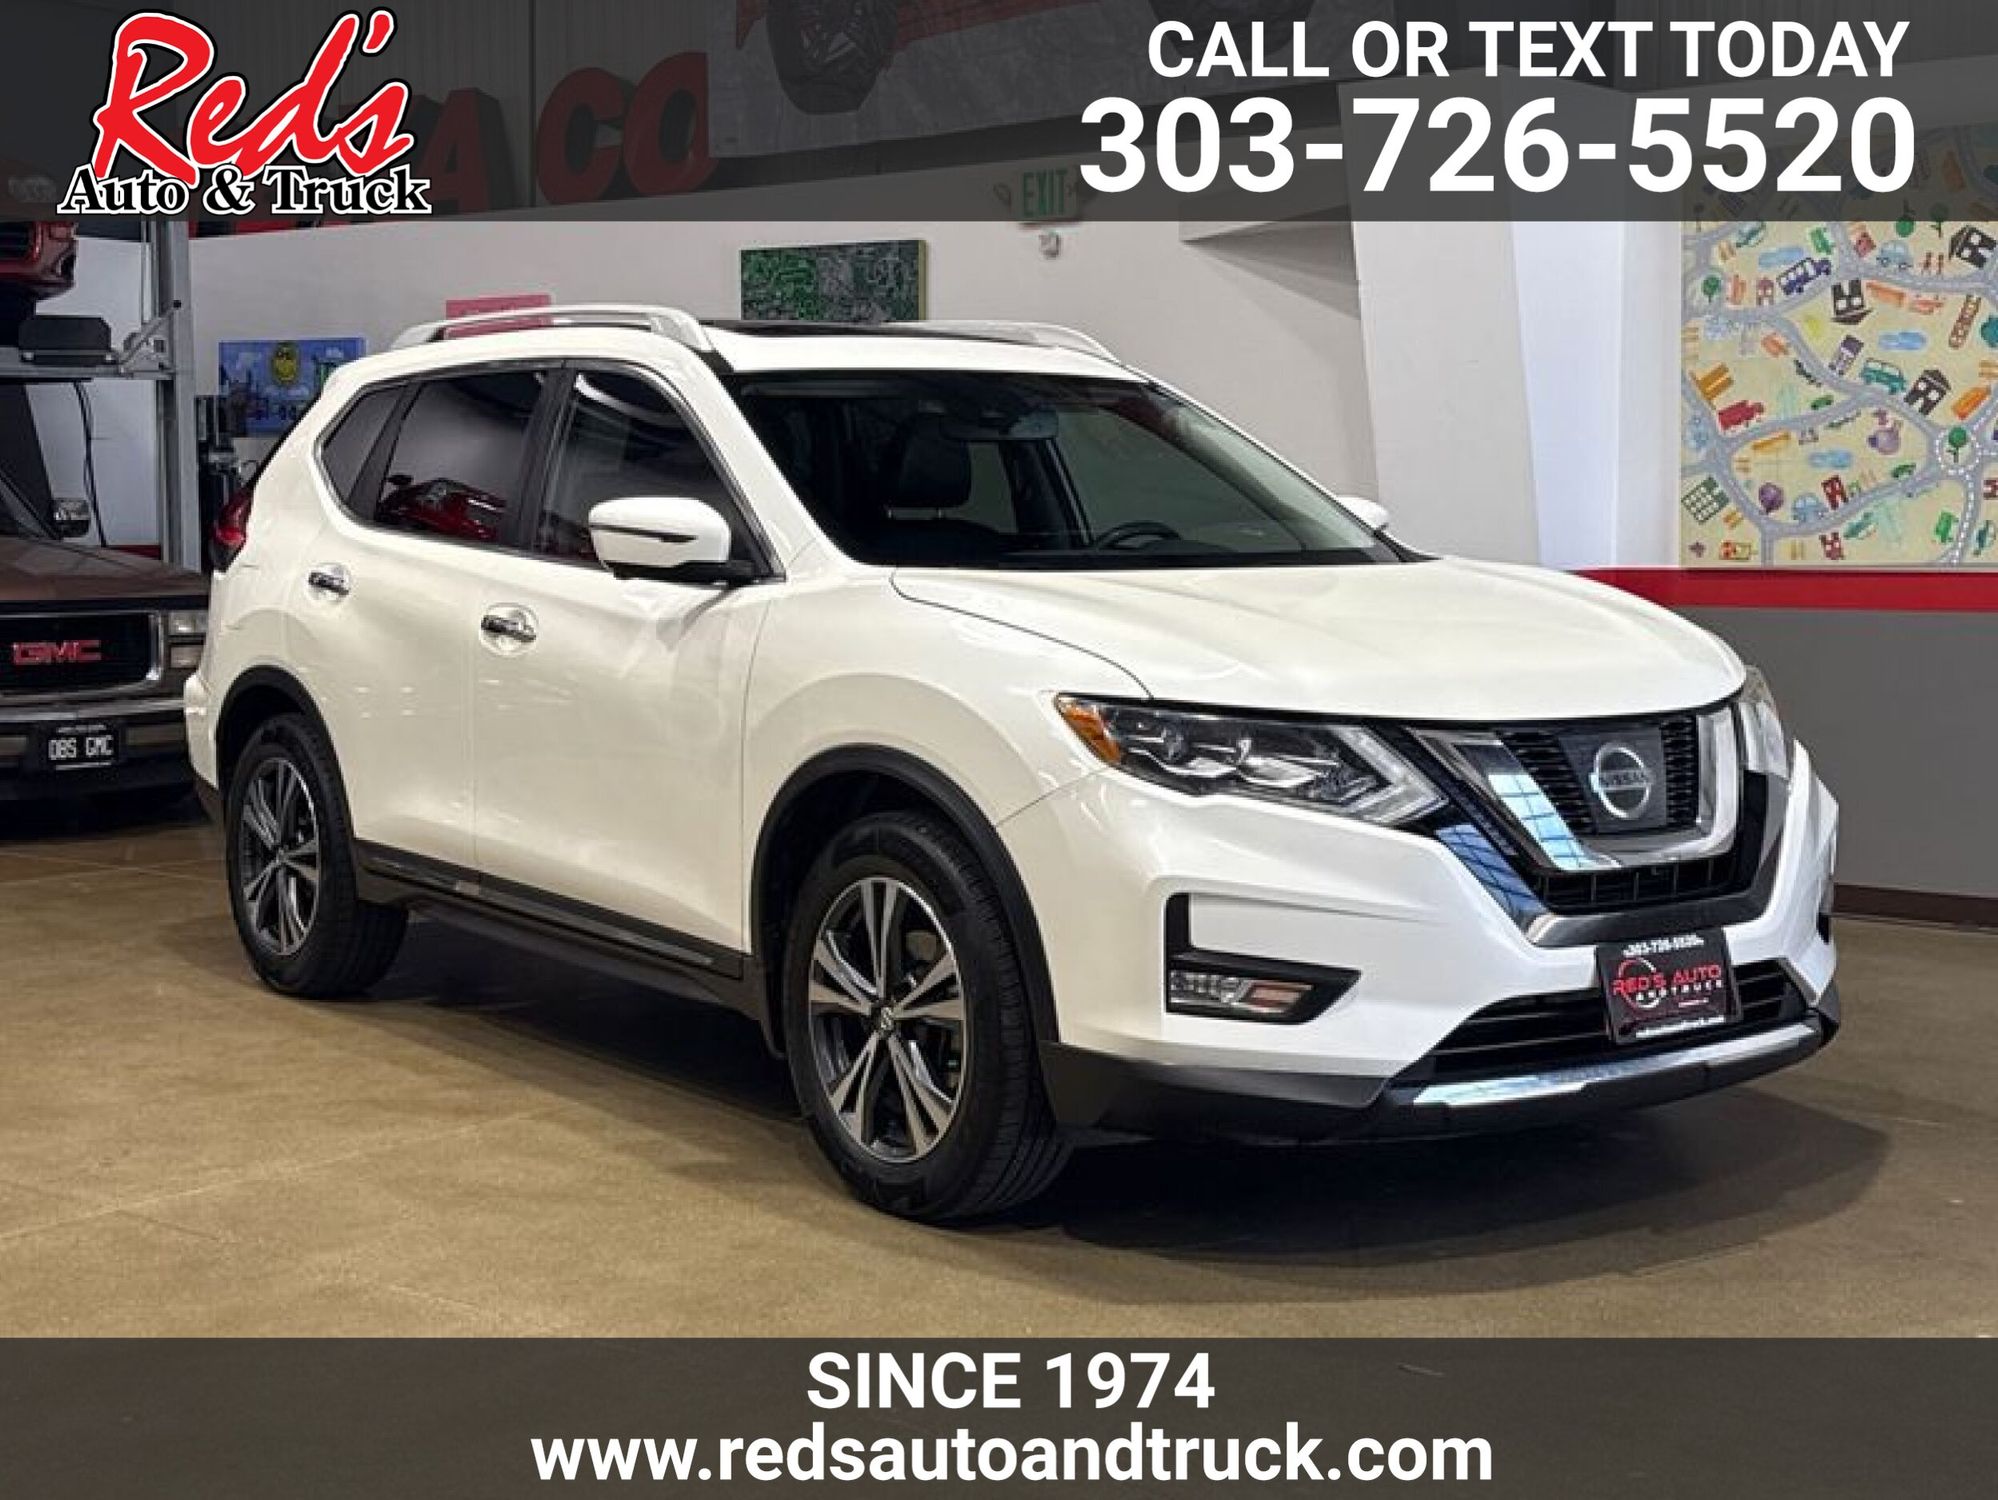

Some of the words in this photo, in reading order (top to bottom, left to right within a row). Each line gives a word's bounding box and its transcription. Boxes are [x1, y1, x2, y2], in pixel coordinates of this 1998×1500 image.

[1023, 168, 1069, 217] EXIT
[13, 640, 101, 665] GMC
[1673, 964, 1722, 985] AUTO
